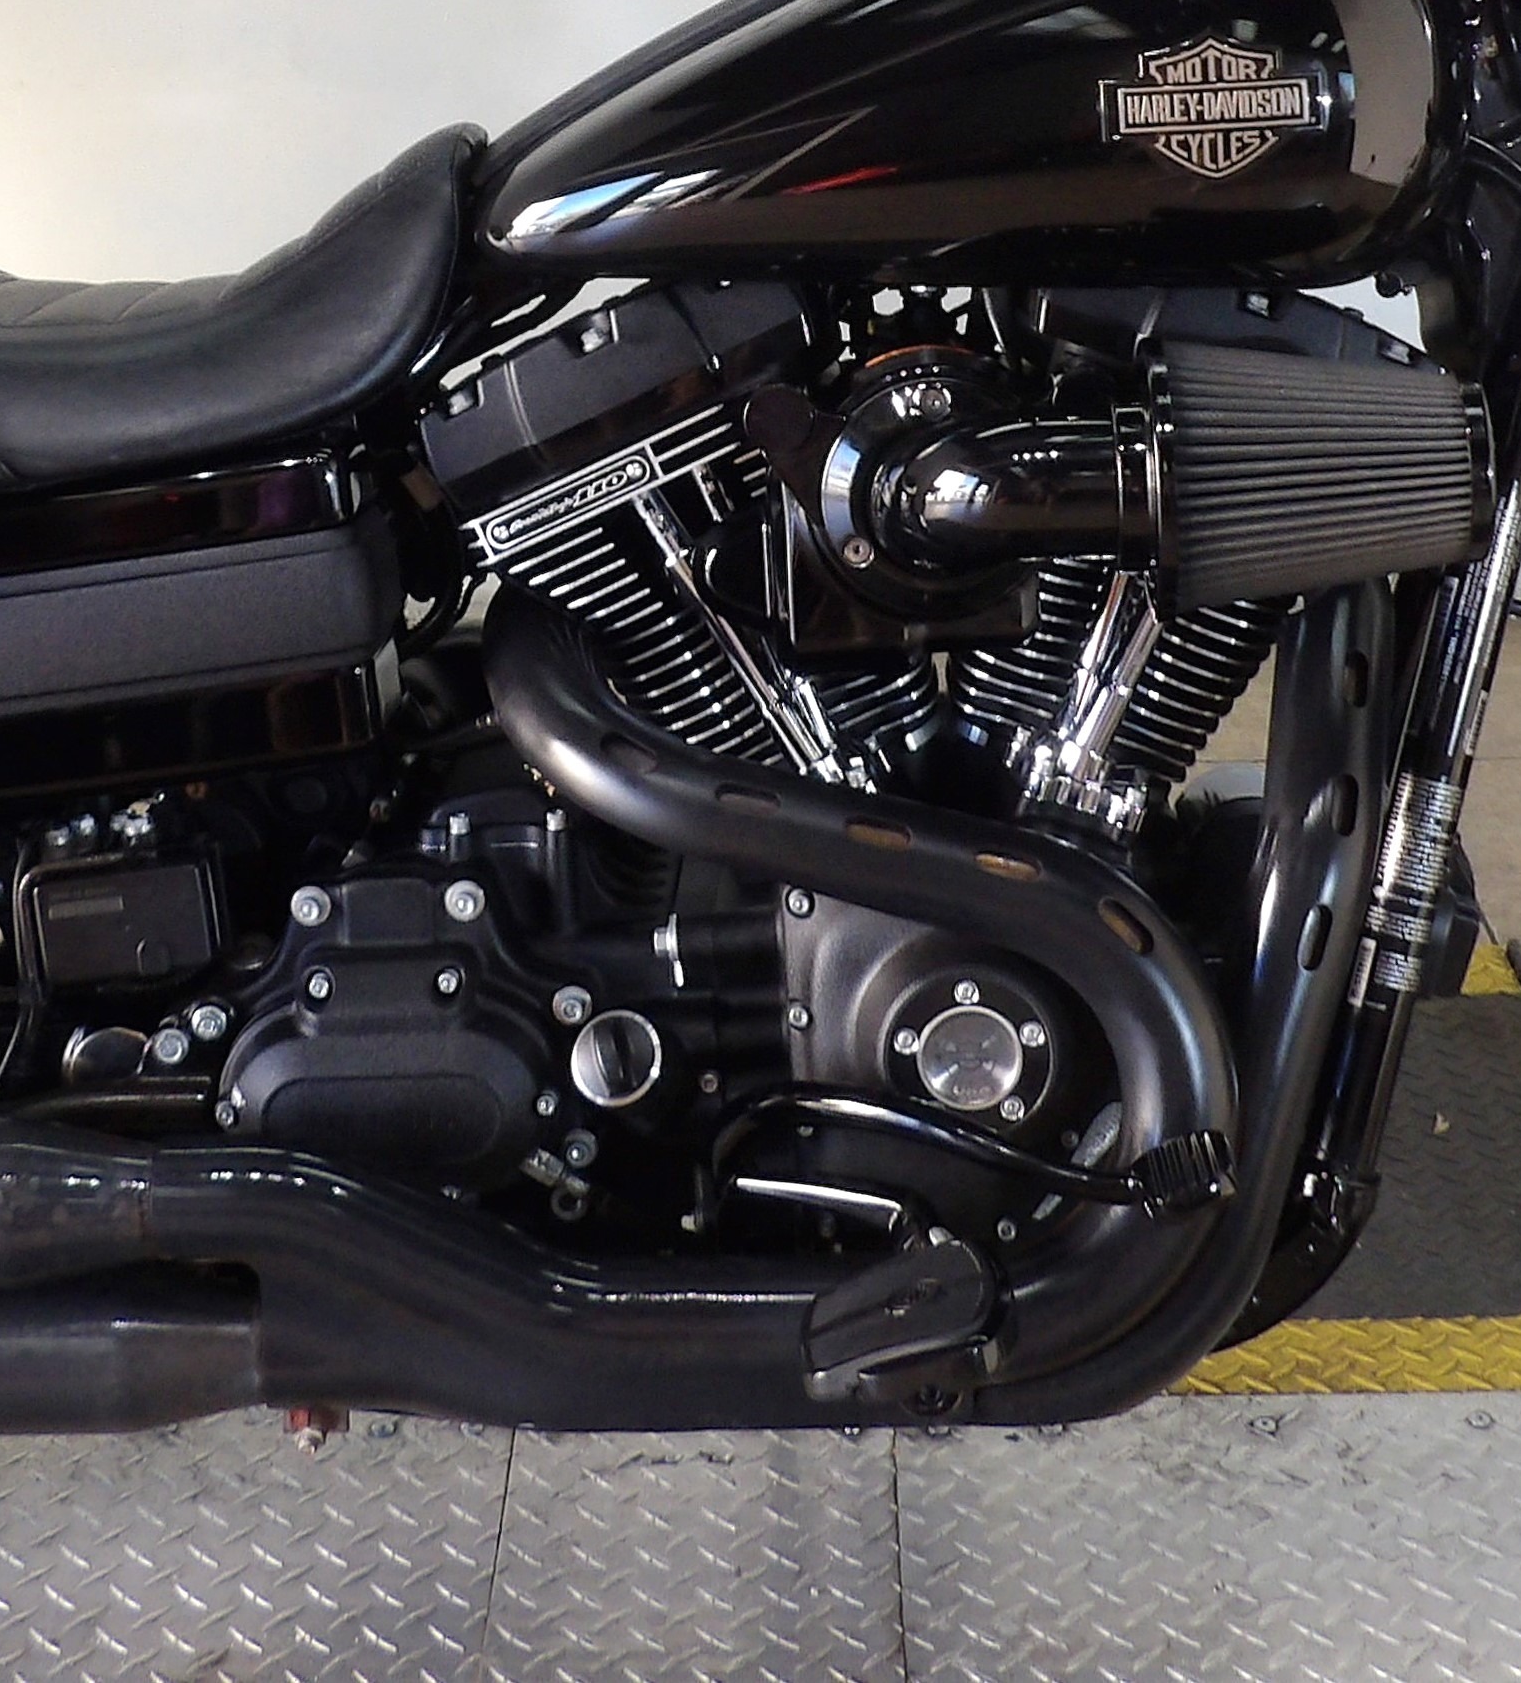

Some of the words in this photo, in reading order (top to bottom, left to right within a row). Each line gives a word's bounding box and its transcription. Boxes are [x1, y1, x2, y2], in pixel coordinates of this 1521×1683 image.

[1166, 47, 1257, 85] MOTOR
[1126, 86, 1301, 125] HARLEY-DAVIDSON
[1171, 130, 1261, 170] CYCLES
